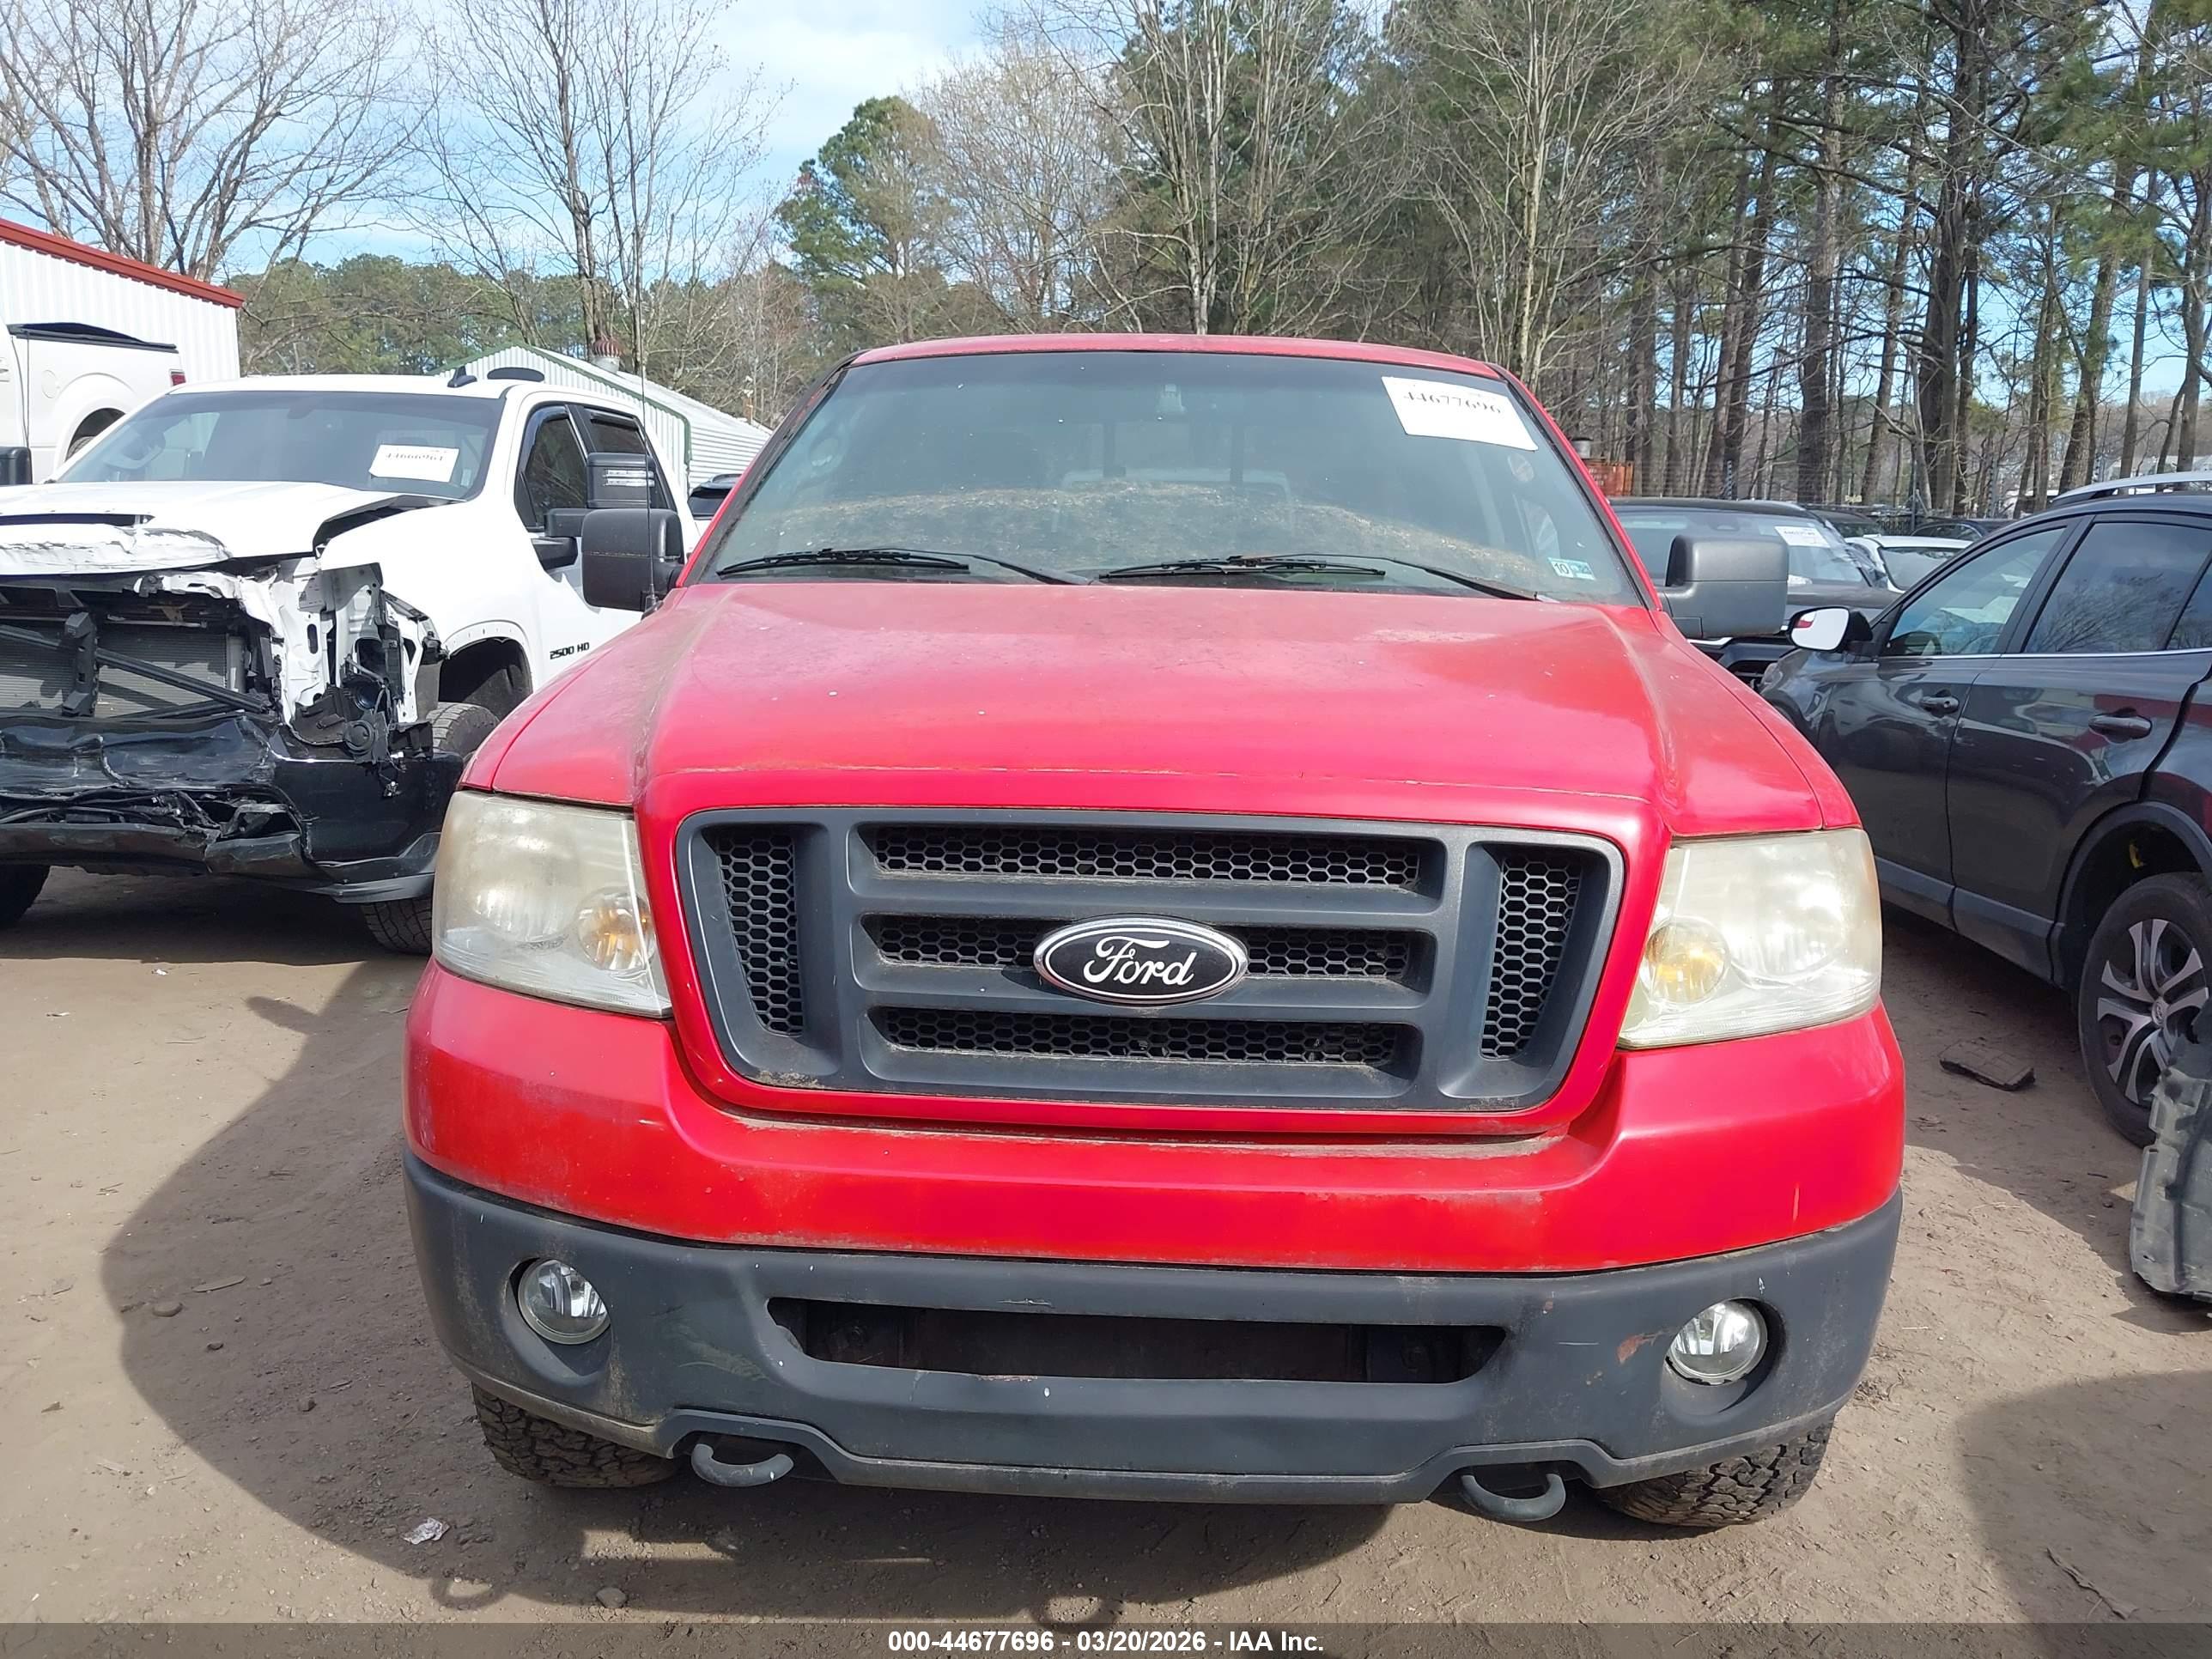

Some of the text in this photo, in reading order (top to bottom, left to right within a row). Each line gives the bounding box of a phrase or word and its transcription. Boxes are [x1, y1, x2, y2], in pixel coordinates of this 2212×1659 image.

[550, 641, 590, 659] 2500 HD
[1083, 935, 1198, 985] Ford
